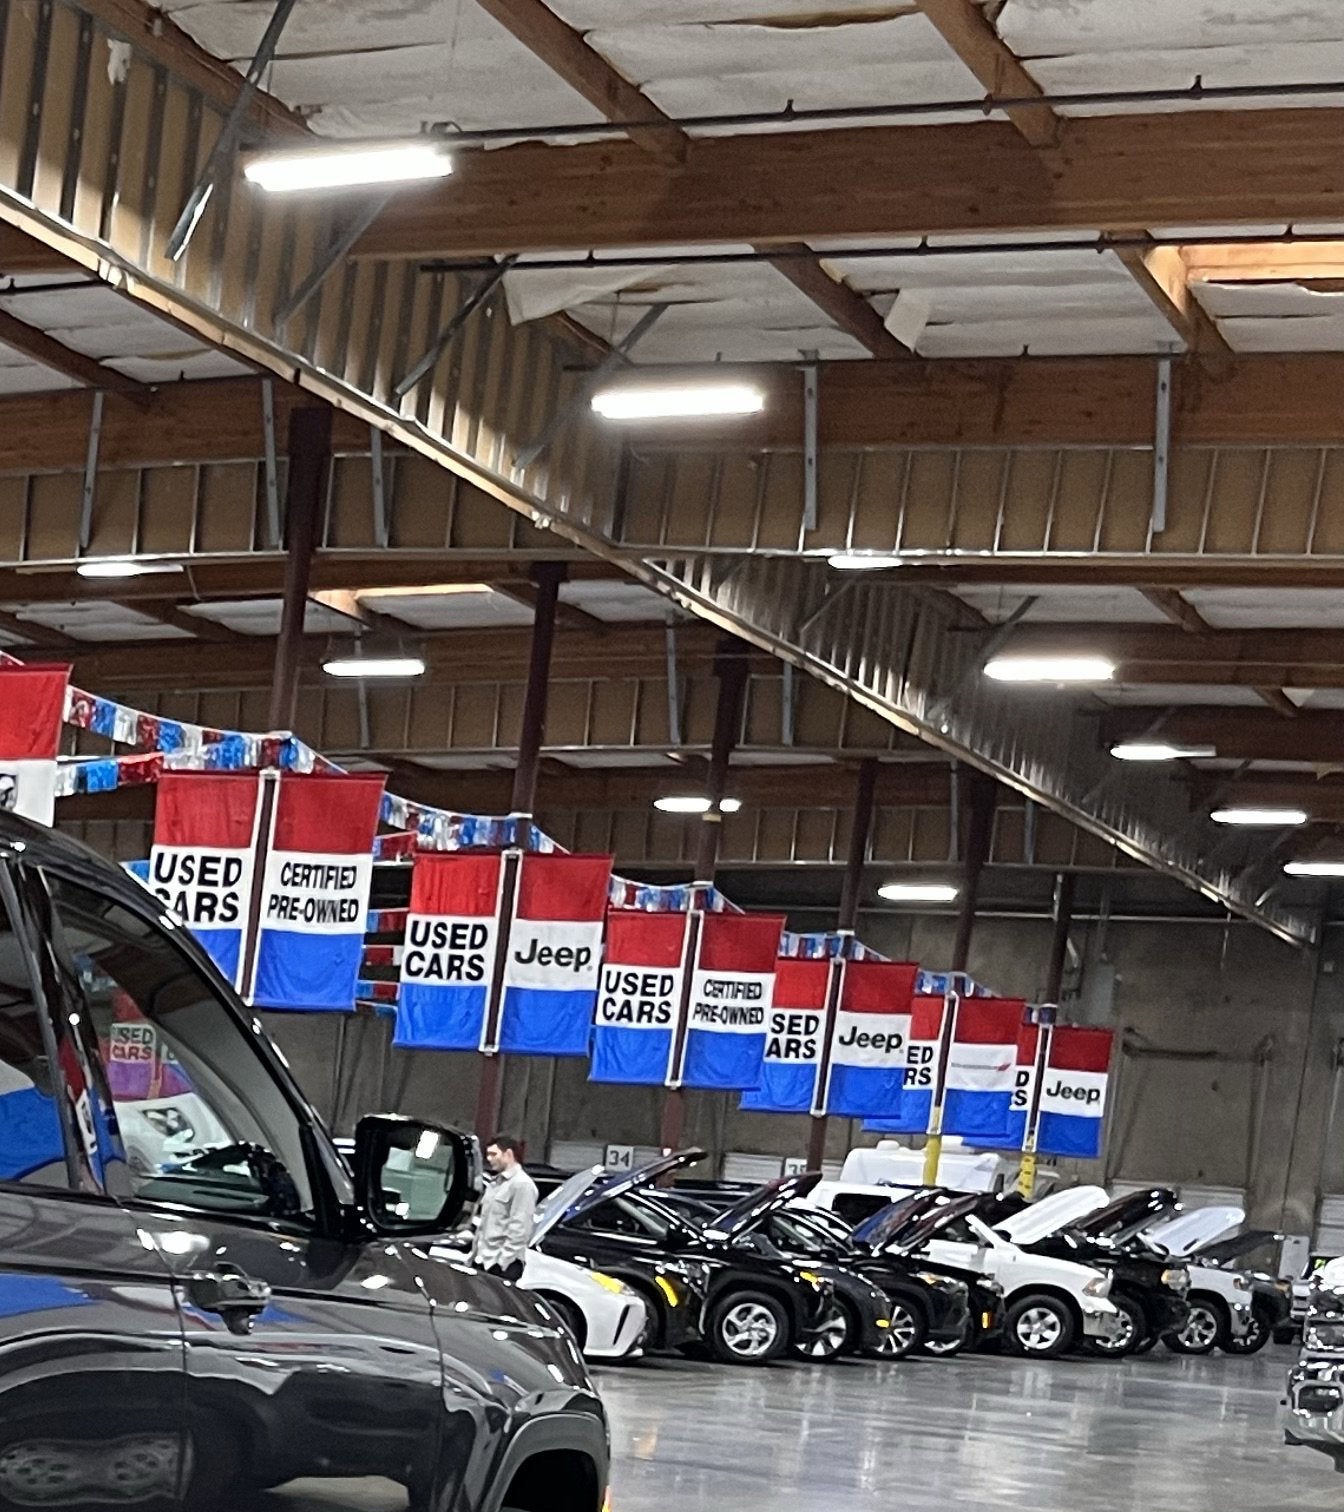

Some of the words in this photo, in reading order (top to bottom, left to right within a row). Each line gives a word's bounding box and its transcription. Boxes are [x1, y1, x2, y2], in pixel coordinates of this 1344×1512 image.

[154, 852, 242, 888] USED
[280, 860, 357, 891] CERTIFIED
[267, 895, 360, 924] PRE-OWNED
[410, 920, 489, 951] USED
[405, 951, 486, 982] CARS
[514, 938, 592, 973] Jeep
[605, 971, 674, 998] USED
[703, 979, 762, 1000] CERTIFIED
[602, 998, 672, 1024] CARS
[692, 1003, 764, 1026] PRE-OWNED
[770, 1013, 820, 1036] SED
[765, 1038, 817, 1059] ARS
[838, 1026, 903, 1053] Jeep
[1046, 1080, 1101, 1105] Jeep
[608, 1150, 630, 1167] 34
